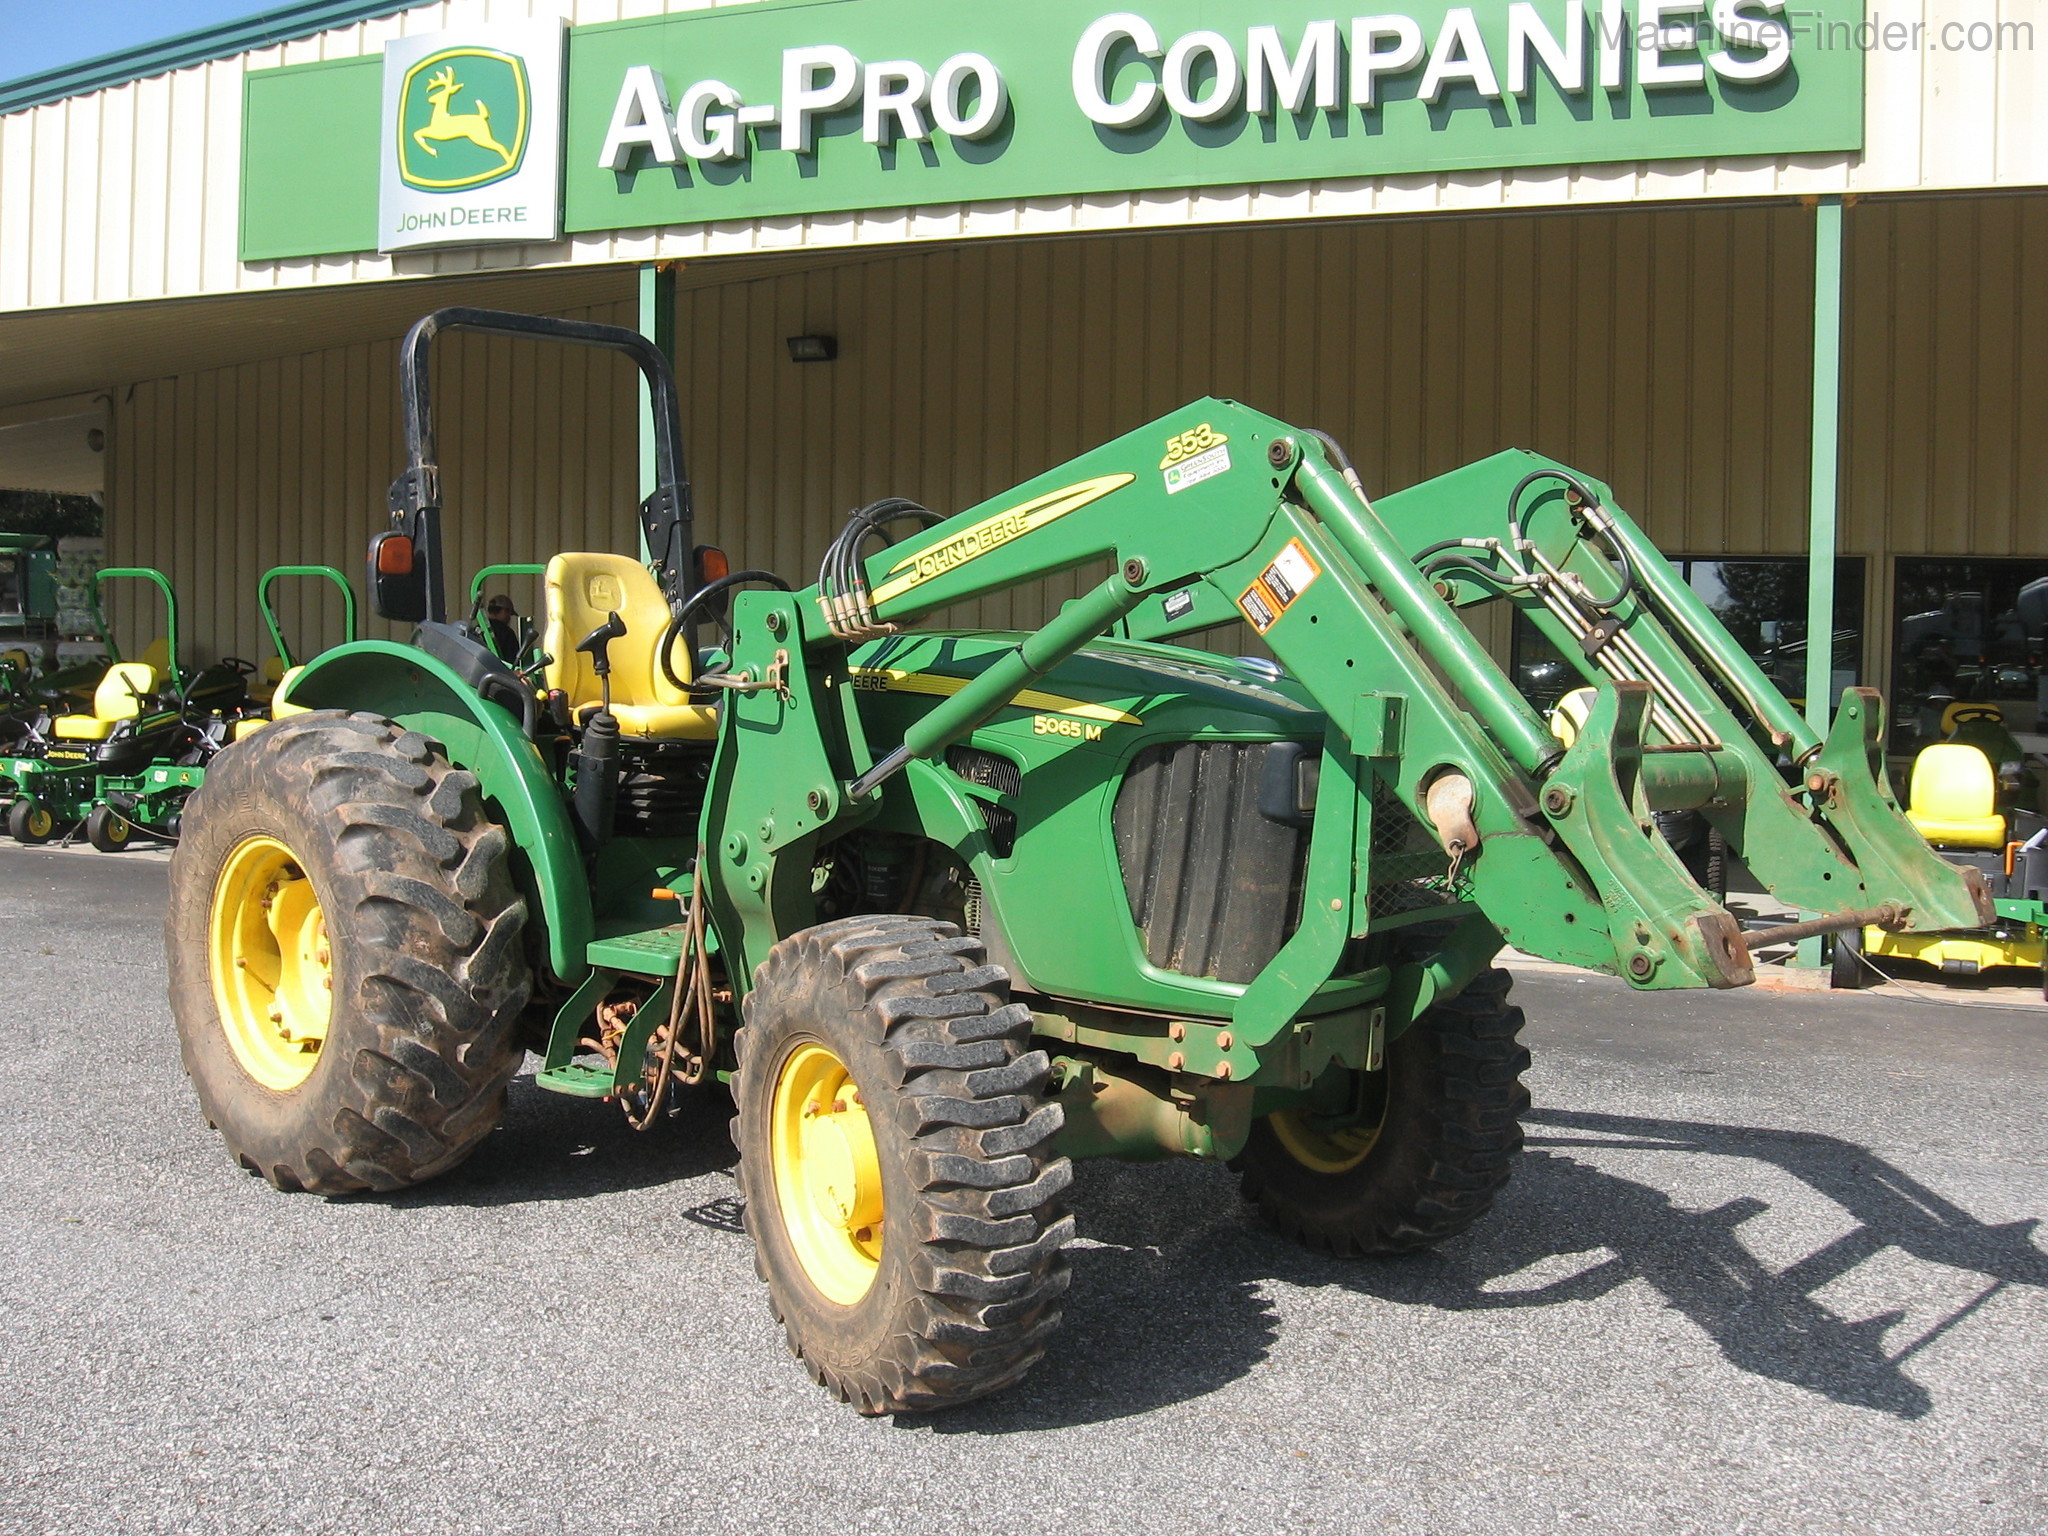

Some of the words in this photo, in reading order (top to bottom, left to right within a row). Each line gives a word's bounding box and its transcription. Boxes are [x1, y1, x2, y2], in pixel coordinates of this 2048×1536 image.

[396, 210, 446, 233] JOHN
[450, 206, 527, 226] DEERE
[1166, 422, 1214, 461] 553
[910, 542, 962, 583] JOHN
[961, 513, 1030, 557] DEERE
[850, 675, 888, 692] EERE
[1033, 714, 1082, 738] 5065
[1084, 723, 1102, 741] M
